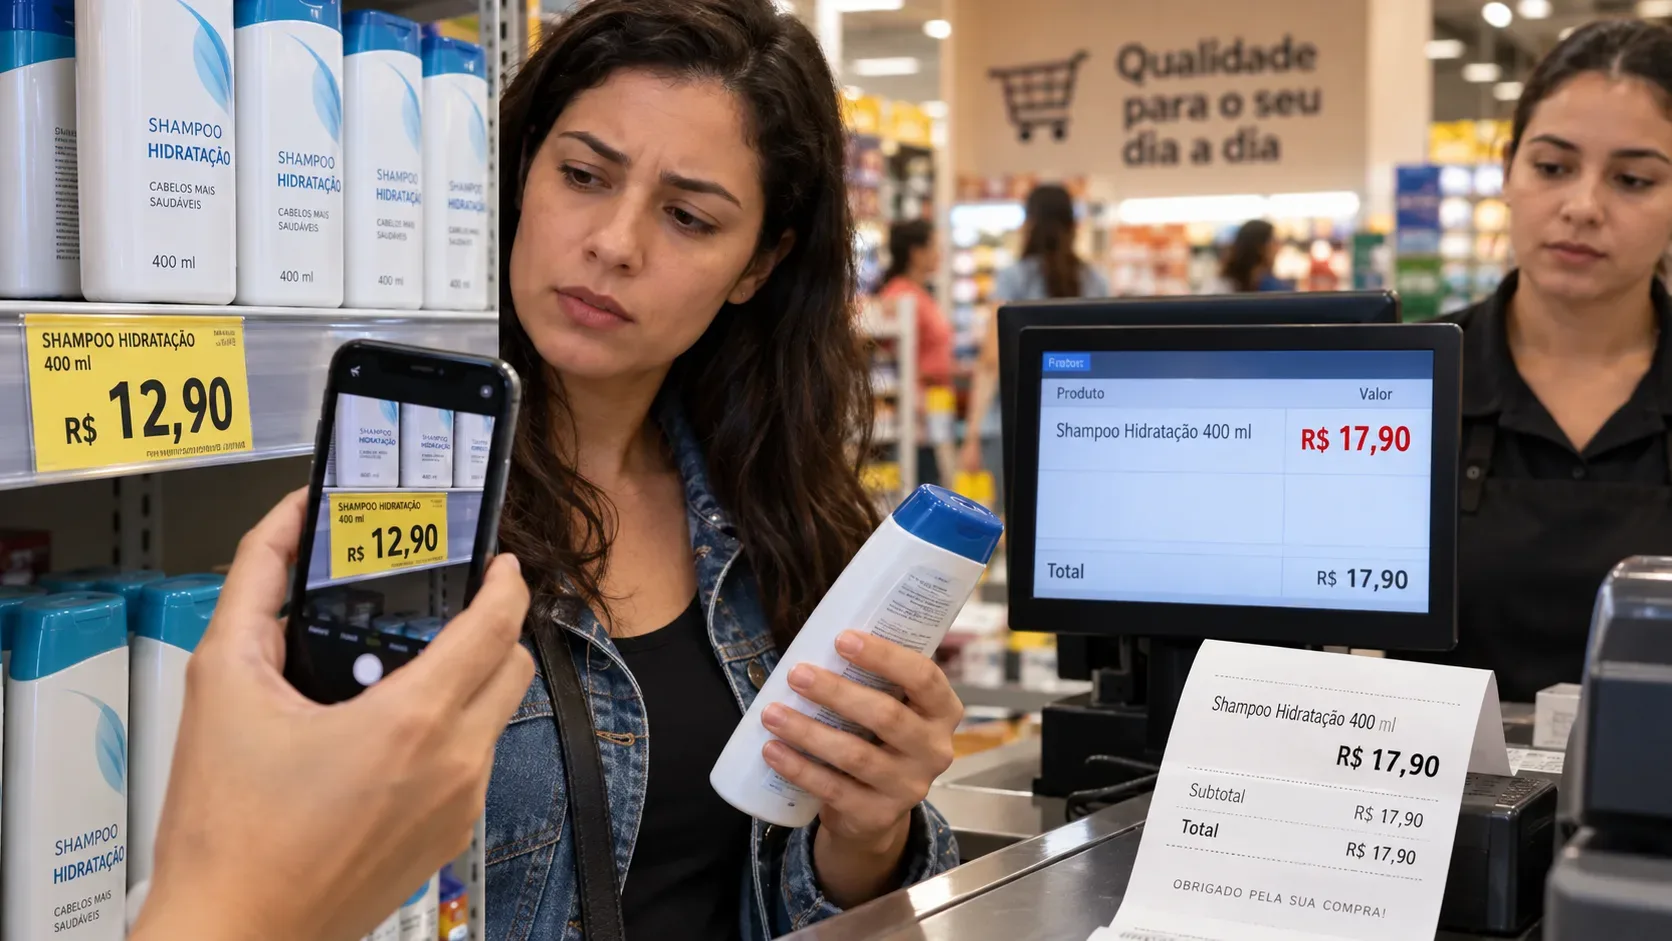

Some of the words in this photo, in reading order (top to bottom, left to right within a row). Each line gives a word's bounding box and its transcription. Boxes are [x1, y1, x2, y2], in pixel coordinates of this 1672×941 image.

[1115, 34, 1318, 86] Qualidade
[1124, 91, 1209, 132] para
[1219, 92, 1244, 118] o
[1254, 87, 1322, 118] seu
[148, 117, 222, 139] SHAMPOO
[148, 142, 231, 168] HIDRATAÇÃO
[1122, 127, 1179, 168] dia
[1191, 138, 1212, 164] a
[1222, 126, 1281, 163] dia
[278, 150, 336, 170] SHAMPOO
[149, 181, 193, 194] CABELOS
[194, 184, 216, 196] MAIS
[277, 172, 342, 195] HIDRATAÇÃO
[376, 168, 419, 186] SHAMPOO
[150, 196, 202, 210] SAUDÁVEIS
[278, 207, 312, 219] CABELOS
[313, 210, 330, 220] MAIS
[152, 254, 177, 269] 400
[181, 255, 196, 270] ml
[280, 270, 299, 283] 400
[302, 271, 314, 284] ml
[378, 275, 393, 286] 400
[42, 332, 115, 348] SHAMPOO
[118, 330, 196, 351] HIDRATAÇÃO
[44, 355, 71, 371] 400
[75, 355, 92, 371] ml
[1057, 387, 1105, 400] Produto
[1359, 387, 1393, 401] Valor
[65, 413, 97, 445] R$
[109, 376, 233, 445] 12,90
[1056, 423, 1120, 441] Shampoo
[1124, 423, 1198, 442] Hidratação
[1202, 423, 1230, 439] 400
[1234, 423, 1251, 439] ml
[1301, 427, 1329, 453] R$
[1340, 425, 1411, 456] 17,90
[338, 502, 377, 512] SHAMPOO
[379, 500, 421, 512] HIDRATAÇÃO
[339, 515, 353, 524] 400
[355, 514, 365, 523] ml
[347, 545, 365, 563] R$
[371, 523, 438, 560] 12,90
[1047, 562, 1084, 579] Total
[1317, 570, 1337, 588] R$
[1347, 568, 1409, 592] 17,90
[1212, 695, 1272, 719] Shampoo
[1275, 703, 1345, 728] Hidratação
[1349, 713, 1376, 730] 400
[1378, 717, 1397, 732] ml
[1336, 745, 1364, 770] R$
[1372, 748, 1440, 778] 17,90
[1189, 782, 1246, 804] Subtotal
[1354, 805, 1374, 823] R$
[1380, 808, 1424, 828] 17,90
[55, 823, 118, 856] SHAMPOO
[1182, 818, 1219, 838] Total
[1345, 842, 1366, 859] R$
[1372, 845, 1416, 865] 17,90
[53, 845, 125, 884] HIDRATAÇÃO
[54, 897, 92, 918] CABELOS
[94, 890, 112, 905] MAIS
[1173, 879, 1243, 898] OBRIGADO
[1249, 889, 1282, 904] PELA
[1289, 895, 1316, 909] SUA
[1322, 900, 1386, 919] COMPRA!
[54, 909, 100, 933] SAUDÁVEIS
